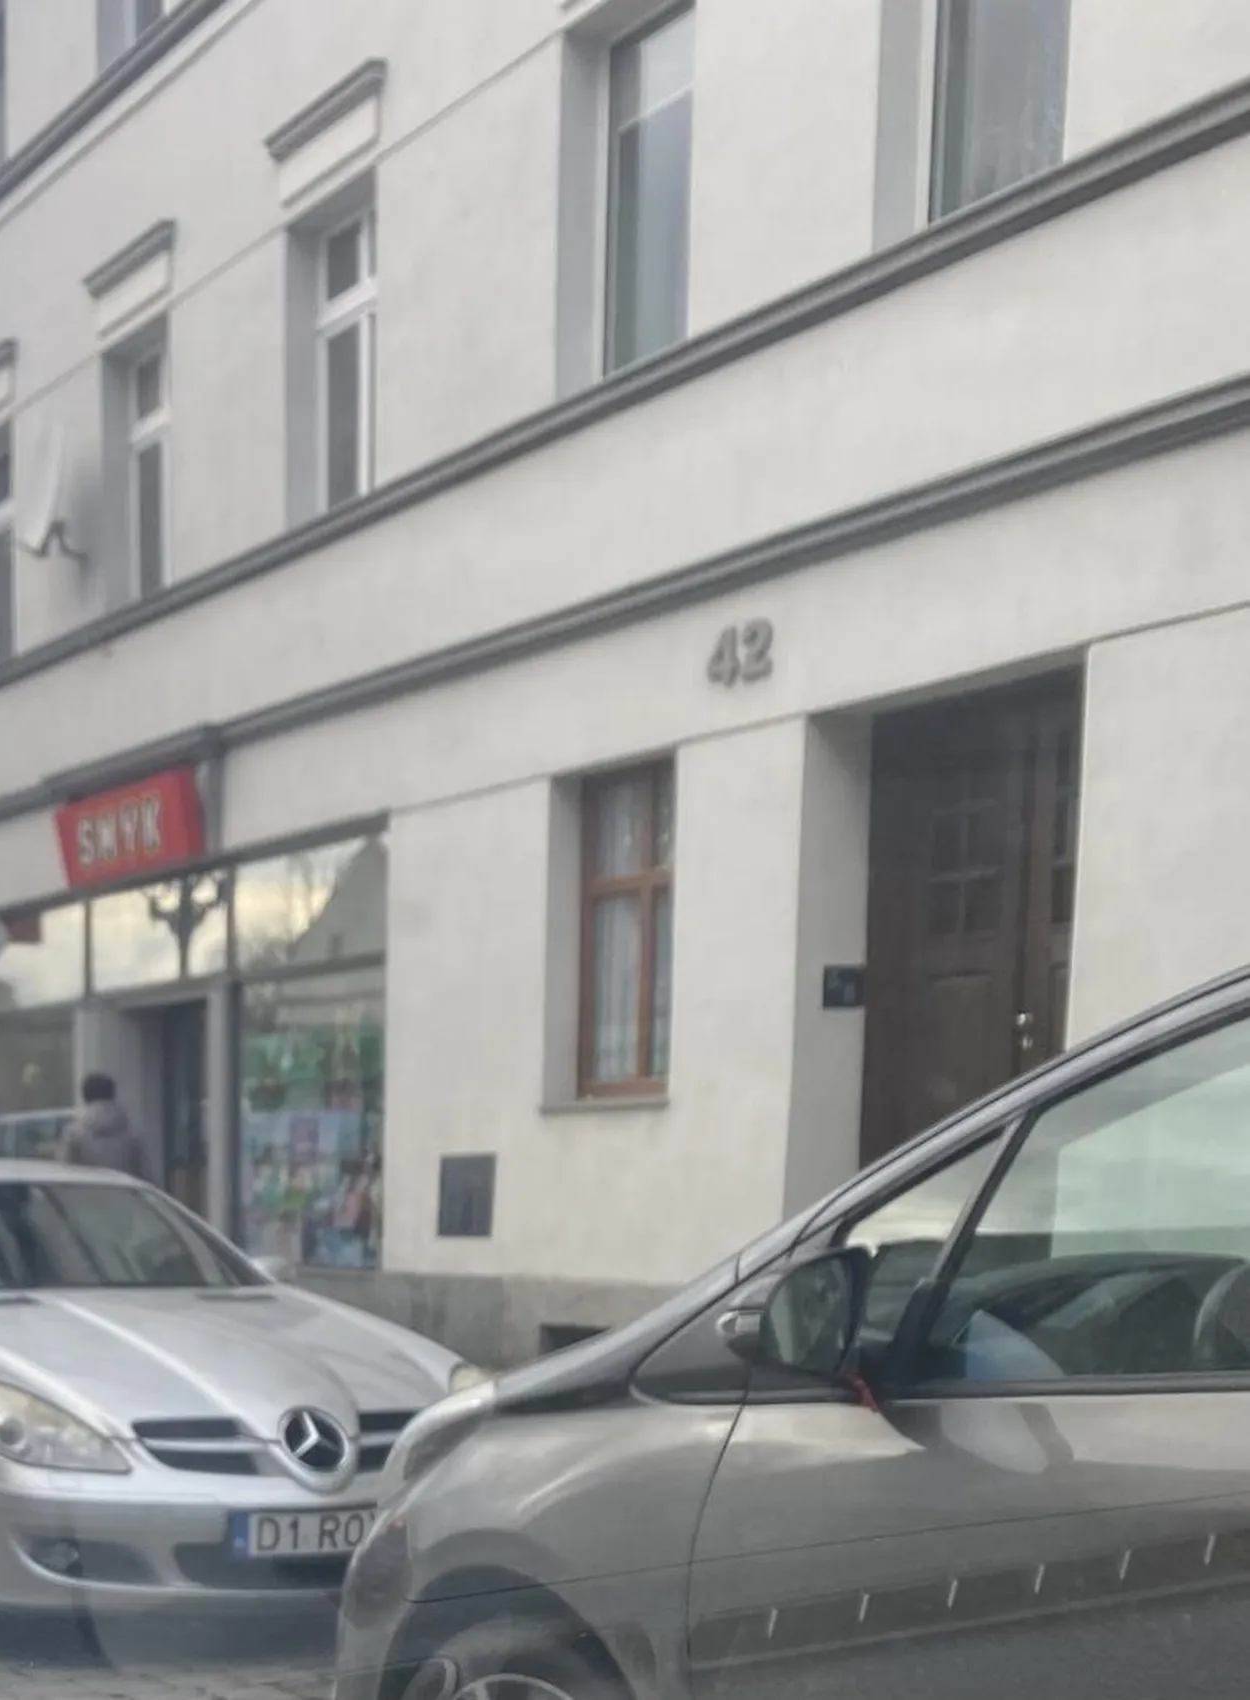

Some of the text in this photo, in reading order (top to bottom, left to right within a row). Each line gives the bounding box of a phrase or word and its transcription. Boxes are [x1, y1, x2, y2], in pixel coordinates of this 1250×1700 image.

[706, 616, 774, 688] 42
[77, 793, 163, 867] SMYK
[257, 1511, 376, 1551] D1 RO
